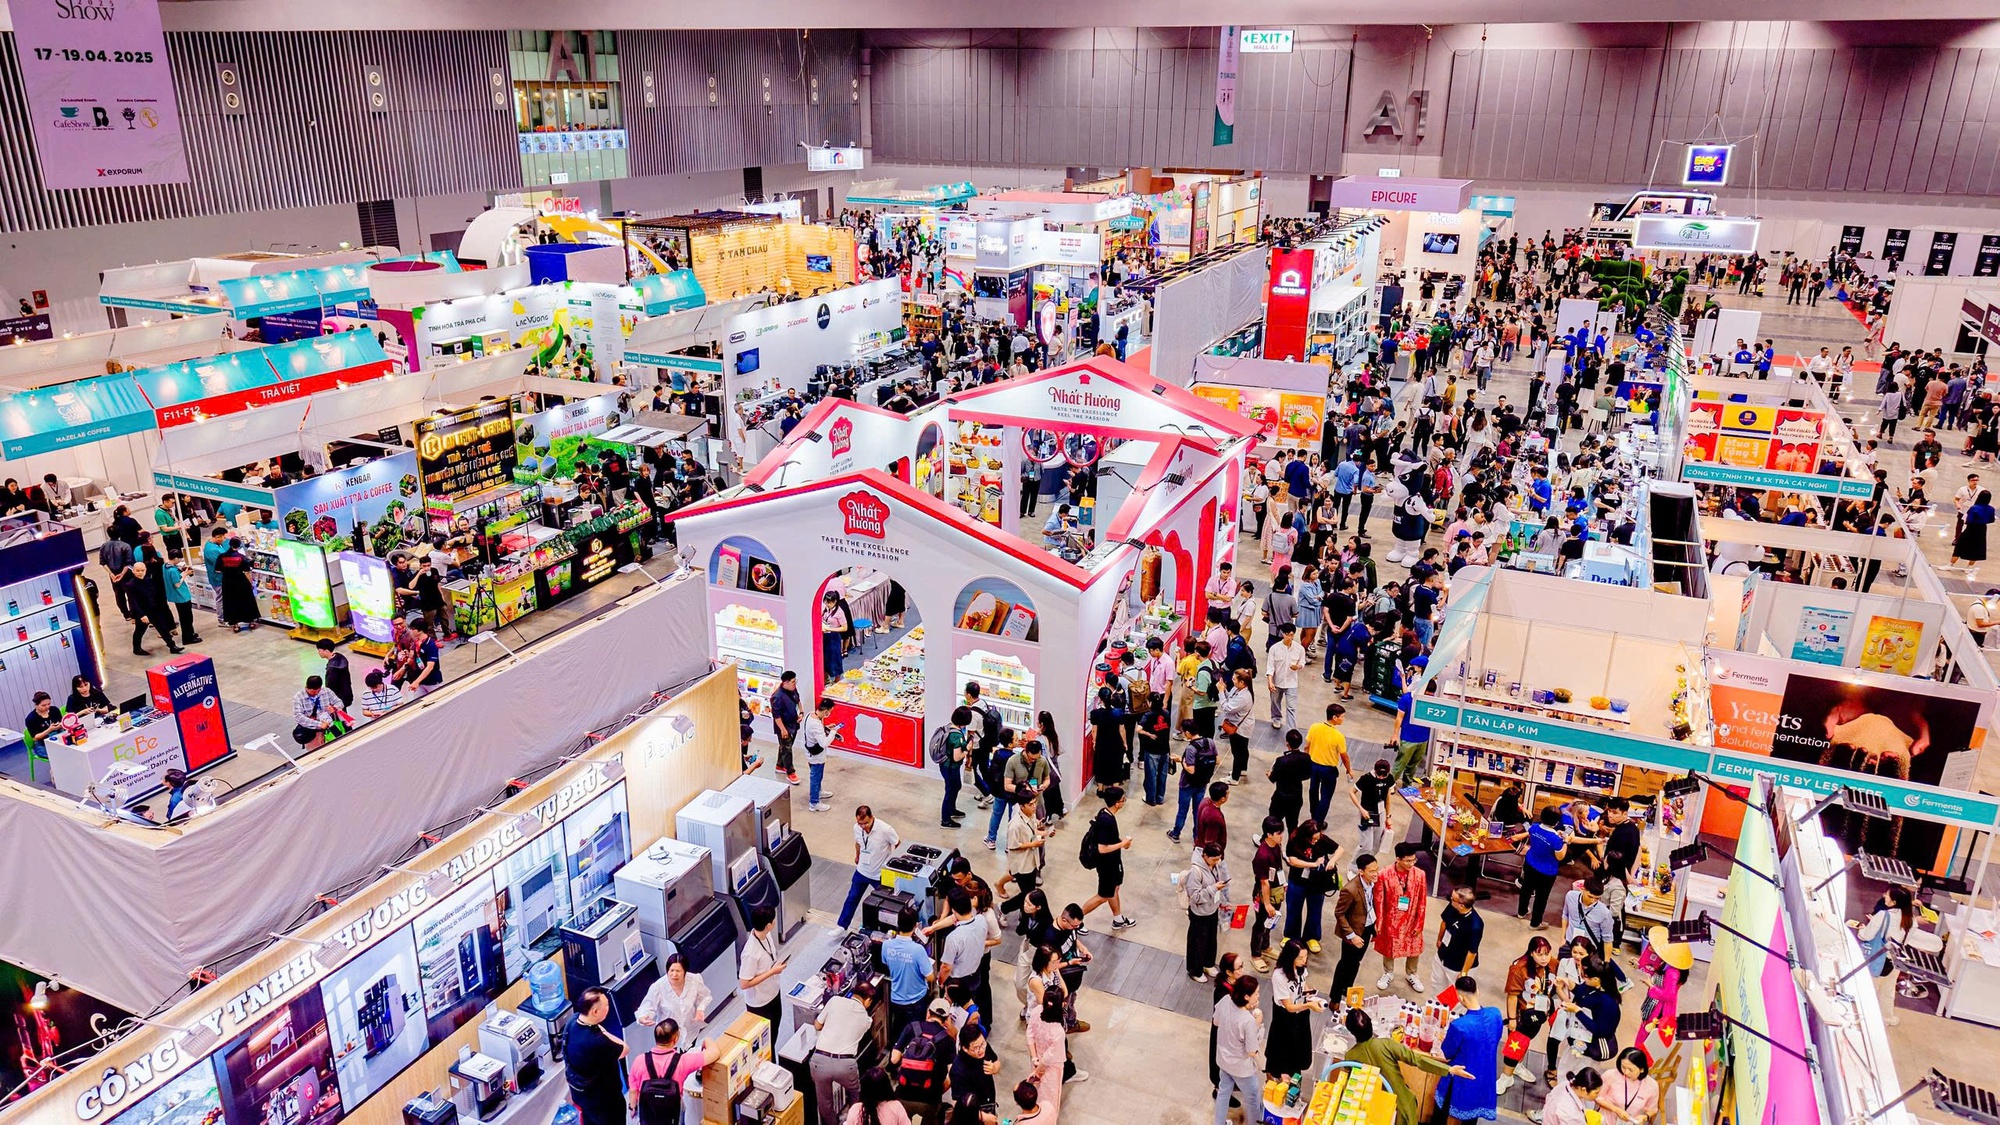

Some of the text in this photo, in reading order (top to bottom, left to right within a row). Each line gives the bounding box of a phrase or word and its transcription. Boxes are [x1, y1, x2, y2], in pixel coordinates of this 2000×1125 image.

[1251, 33, 1282, 43] EXIT
[1371, 191, 1417, 204] EPICURE
[164, 382, 301, 420] F11-F12 TRÀ VIỆT
[1048, 386, 1121, 411] Nhất Hương
[1082, 409, 1118, 417] EXCELLENCE
[1284, 403, 1313, 411] CANNED
[588, 415, 605, 427] COFFEE
[56, 432, 86, 443] MAZELAB
[87, 426, 111, 436] COFFEE
[1725, 438, 1750, 448] Mua
[345, 473, 372, 488] KENBAR
[1687, 467, 1708, 478] CÔNG
[1710, 471, 1720, 479] TY
[1721, 472, 1743, 482] TNHH
[1744, 475, 1755, 483] TM
[1774, 477, 1790, 487] TRÀ
[1808, 481, 1828, 490] NGHI
[205, 485, 219, 493] FOOD
[313, 500, 329, 516] SẢN
[329, 494, 348, 511] XUẤT
[363, 491, 369, 503] &
[370, 482, 393, 500] COFFEE
[846, 500, 882, 521] Nhất
[849, 515, 881, 534] Hương
[821, 535, 843, 544] TASTE
[863, 543, 909, 556] EXCELLENCE
[831, 545, 899, 561] FEEL THE PASSION
[1732, 671, 1769, 683] Fermentis
[173, 675, 213, 698] ALTERNATIVE
[1427, 707, 1539, 736] F27 TÂN LẬP KIM
[1730, 701, 1803, 731] Yeasts
[197, 721, 209, 733] OAT
[1720, 736, 1774, 752] solutions
[1750, 726, 1831, 750] fermentation
[113, 735, 158, 762] FoBe
[150, 754, 180, 771] Dairy Co.
[134, 771, 156, 785] Việt Nam
[1793, 775, 1812, 787] BY
[1922, 798, 1963, 812] Fermentis
[423, 903, 466, 936] Enjoy coffee time
[458, 909, 474, 923] within
[76, 1040, 178, 1120] CÔNG
[227, 951, 315, 1024] TNHH
[530, 795, 557, 824] VỤ
